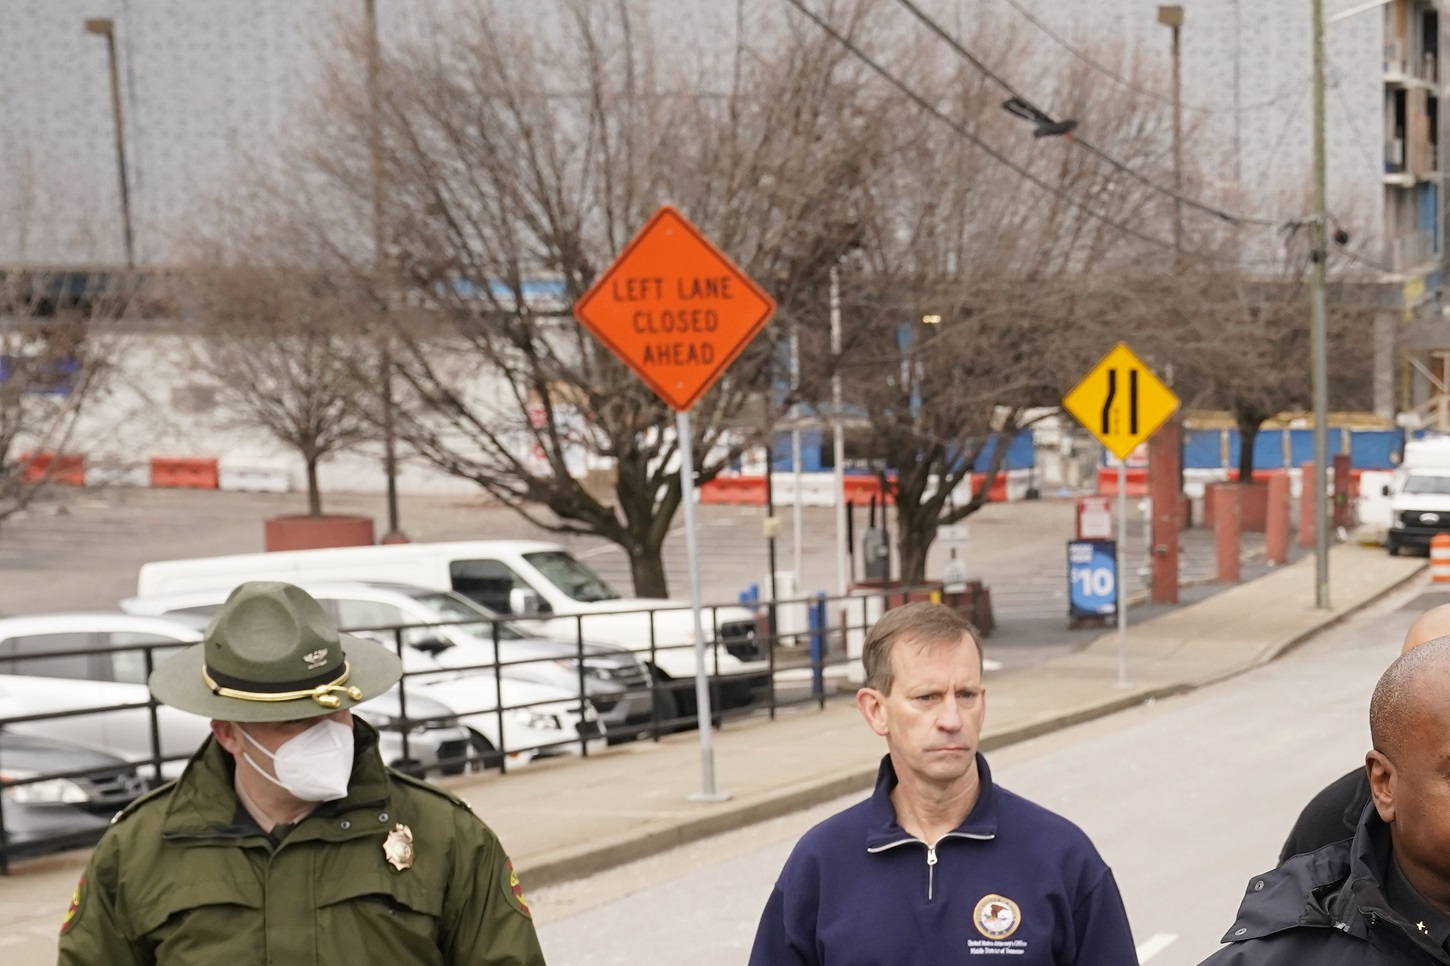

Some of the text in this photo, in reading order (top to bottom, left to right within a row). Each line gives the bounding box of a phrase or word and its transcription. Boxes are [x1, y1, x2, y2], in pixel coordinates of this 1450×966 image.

[612, 276, 733, 302] LEFT LANE
[633, 309, 718, 334] CLOSED
[643, 342, 715, 366] AHEAD
